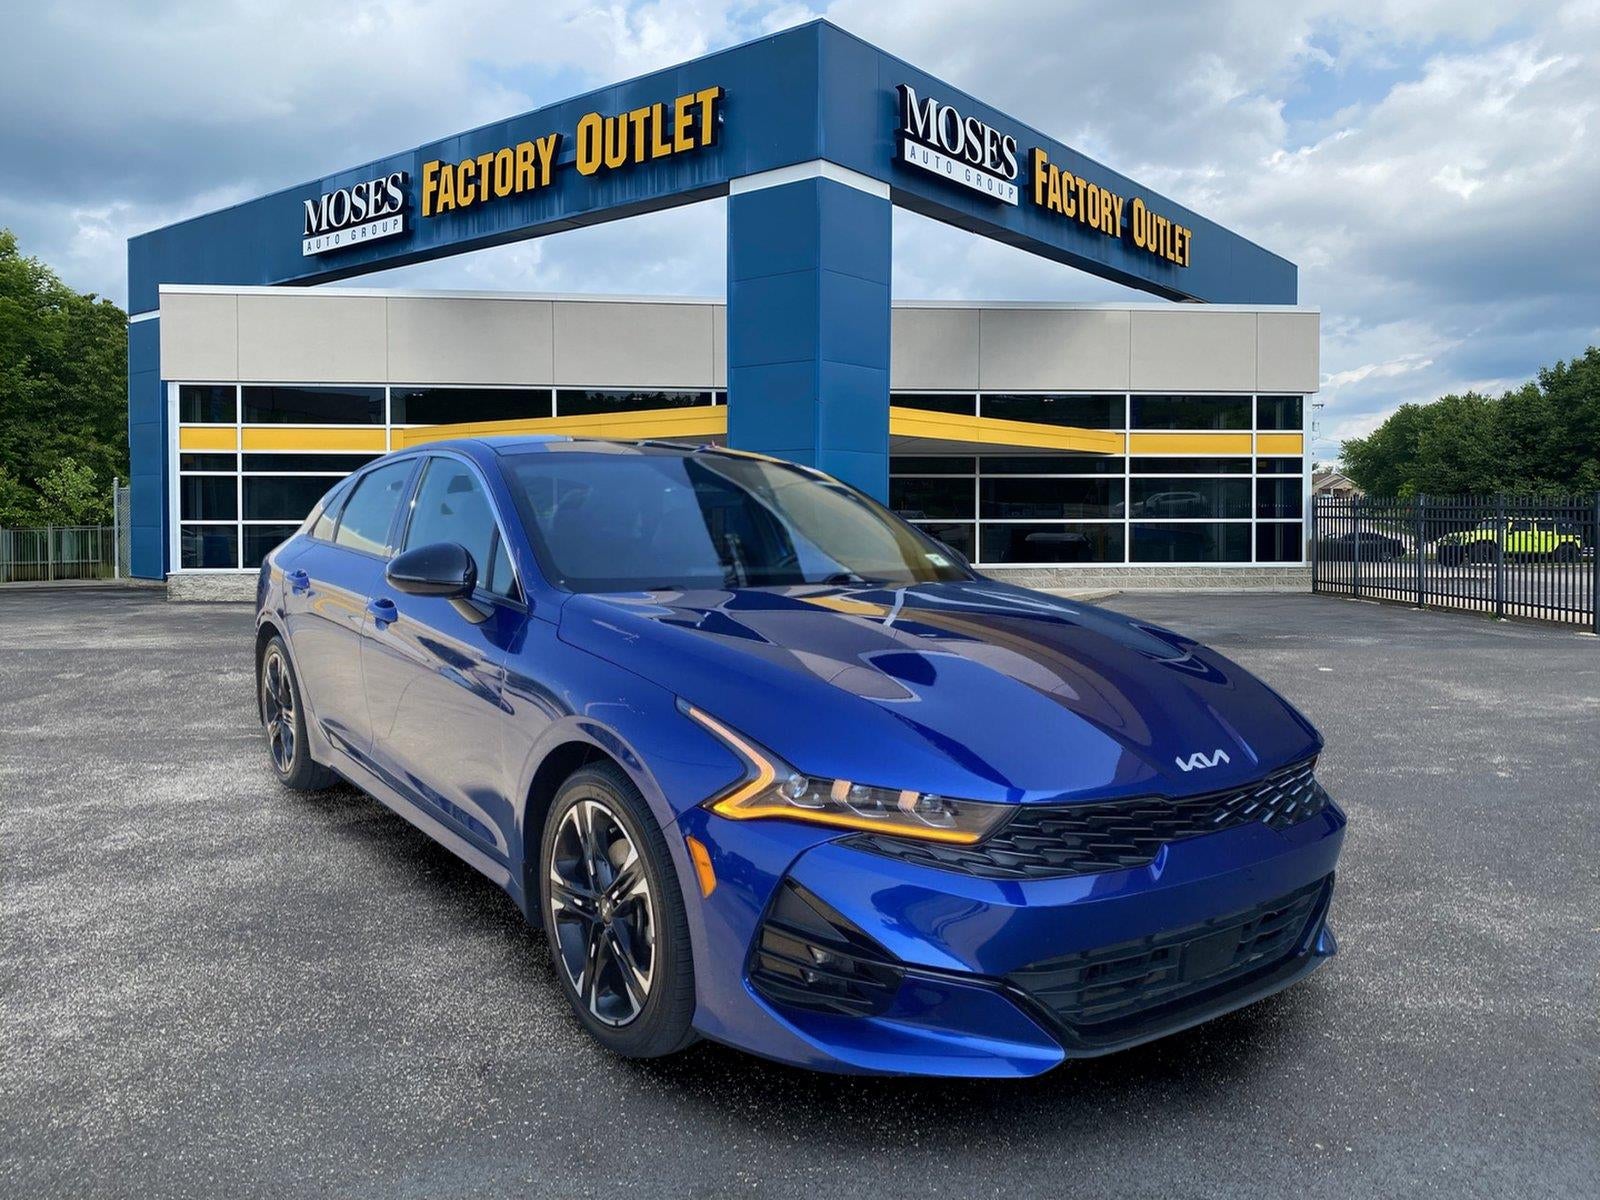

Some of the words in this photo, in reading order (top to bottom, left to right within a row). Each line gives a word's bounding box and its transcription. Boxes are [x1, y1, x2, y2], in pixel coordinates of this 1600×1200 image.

[422, 134, 559, 217] FACTORY
[576, 86, 720, 176] OUTLET
[904, 84, 1018, 180] MOSES
[303, 172, 403, 235] MOSES
[910, 146, 952, 175] AUTO
[965, 169, 1014, 199] GROUP
[1034, 147, 1124, 238] FACTORY
[1131, 197, 1192, 267] OUTLET
[307, 234, 340, 252] AUTO
[351, 219, 399, 241] GROUP
